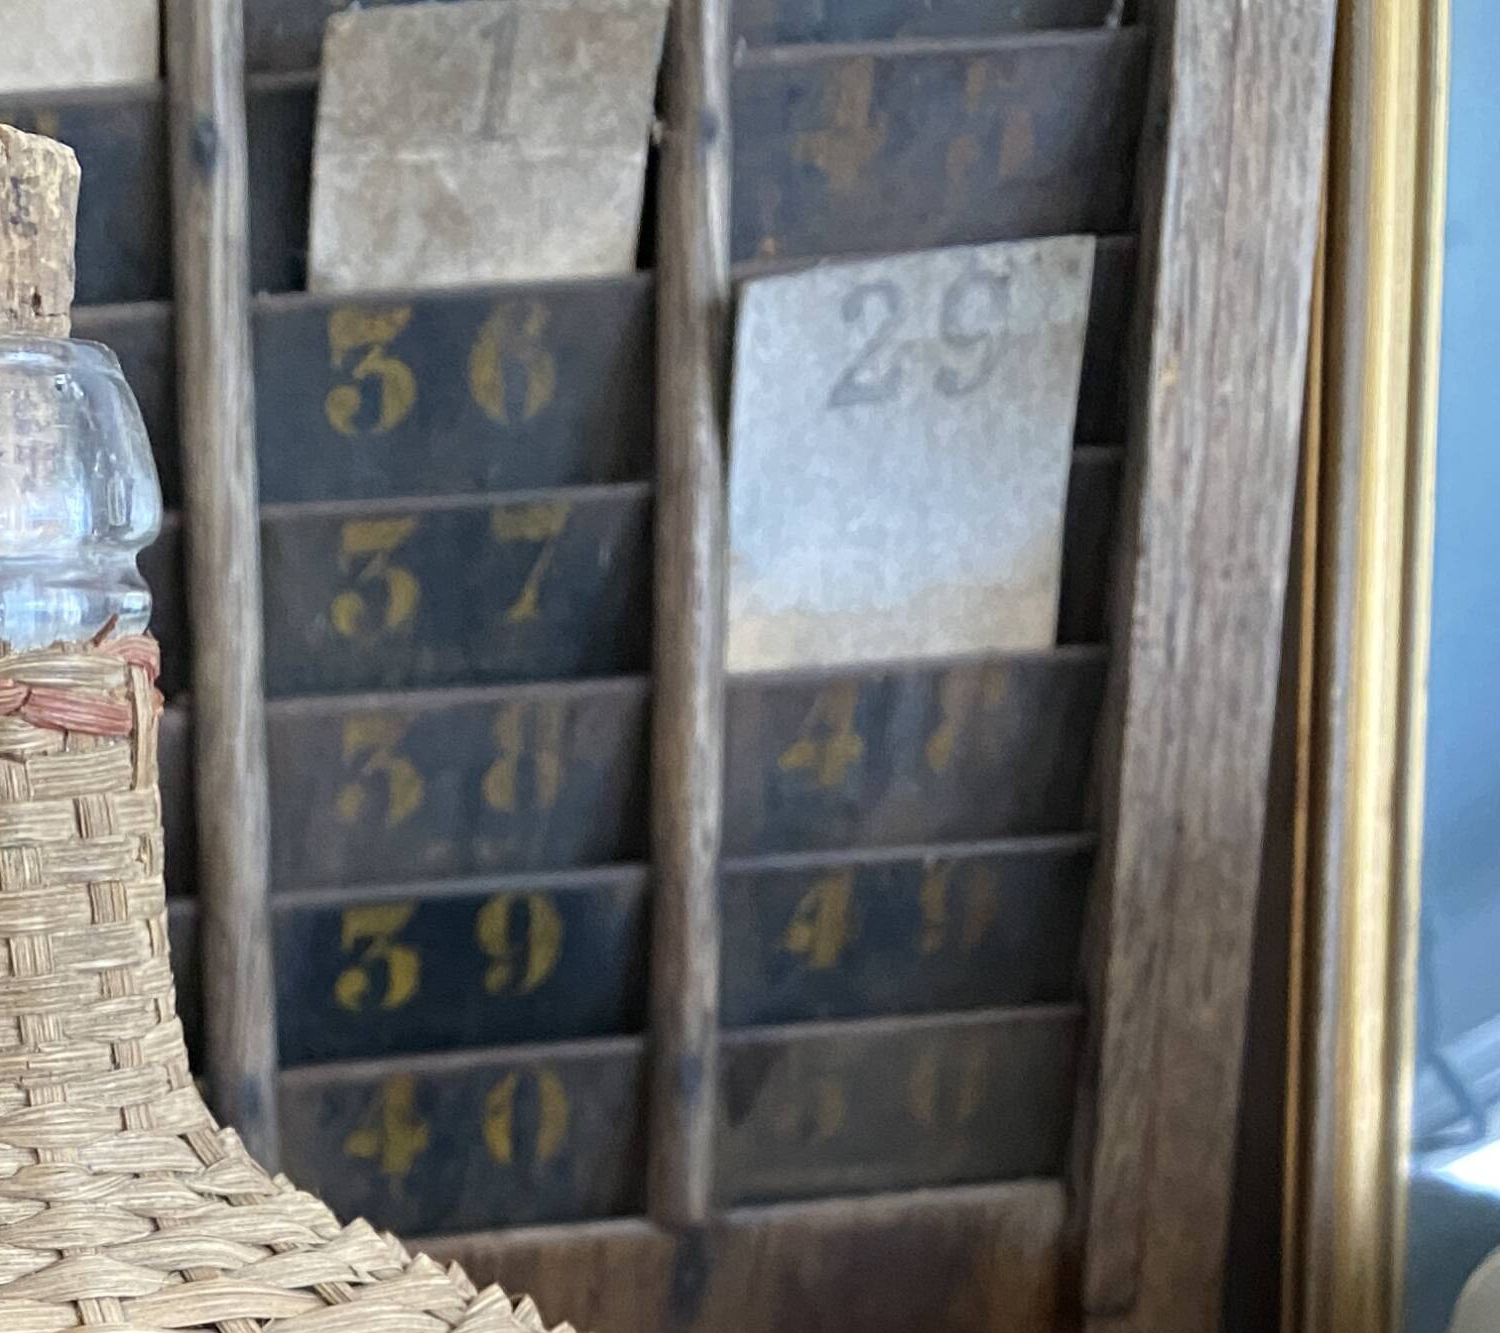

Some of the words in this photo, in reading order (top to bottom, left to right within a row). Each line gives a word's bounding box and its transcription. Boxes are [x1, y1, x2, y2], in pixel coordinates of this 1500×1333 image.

[325, 301, 556, 436] 36
[827, 270, 1014, 408] 29
[331, 500, 571, 638] 37
[334, 889, 564, 1011] 39
